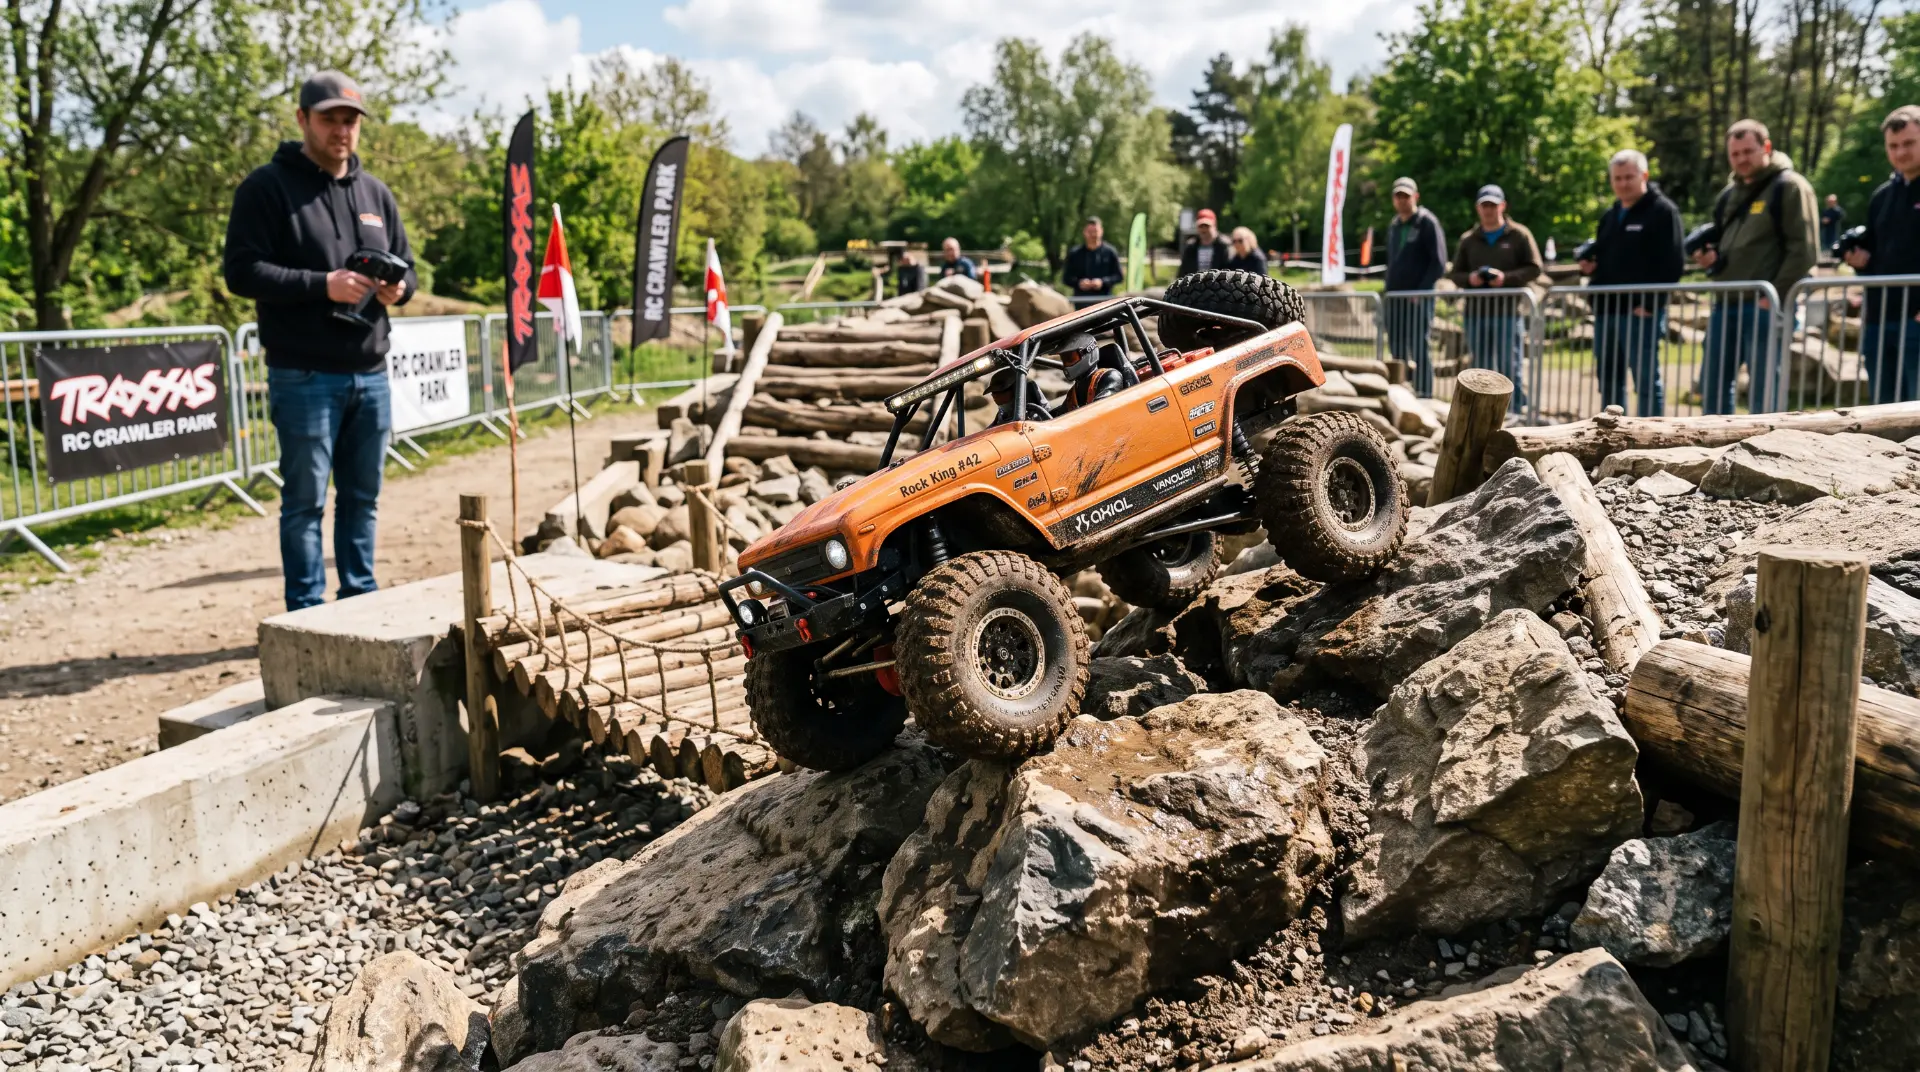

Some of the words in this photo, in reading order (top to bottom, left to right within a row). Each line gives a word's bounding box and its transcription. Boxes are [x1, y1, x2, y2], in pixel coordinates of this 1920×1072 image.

[654, 162, 678, 211] PARK
[646, 214, 672, 295] CRAWLER
[644, 296, 664, 321] RC
[392, 353, 408, 379] RC
[411, 348, 462, 376] CRAWLER
[50, 362, 217, 426] TRAXXAS
[420, 378, 450, 404] PARK
[61, 431, 92, 453] RC
[93, 418, 176, 449] CRAWLER
[177, 412, 218, 435] PARK
[899, 478, 930, 498] Rock
[930, 466, 957, 485] King
[957, 453, 982, 472] #42
